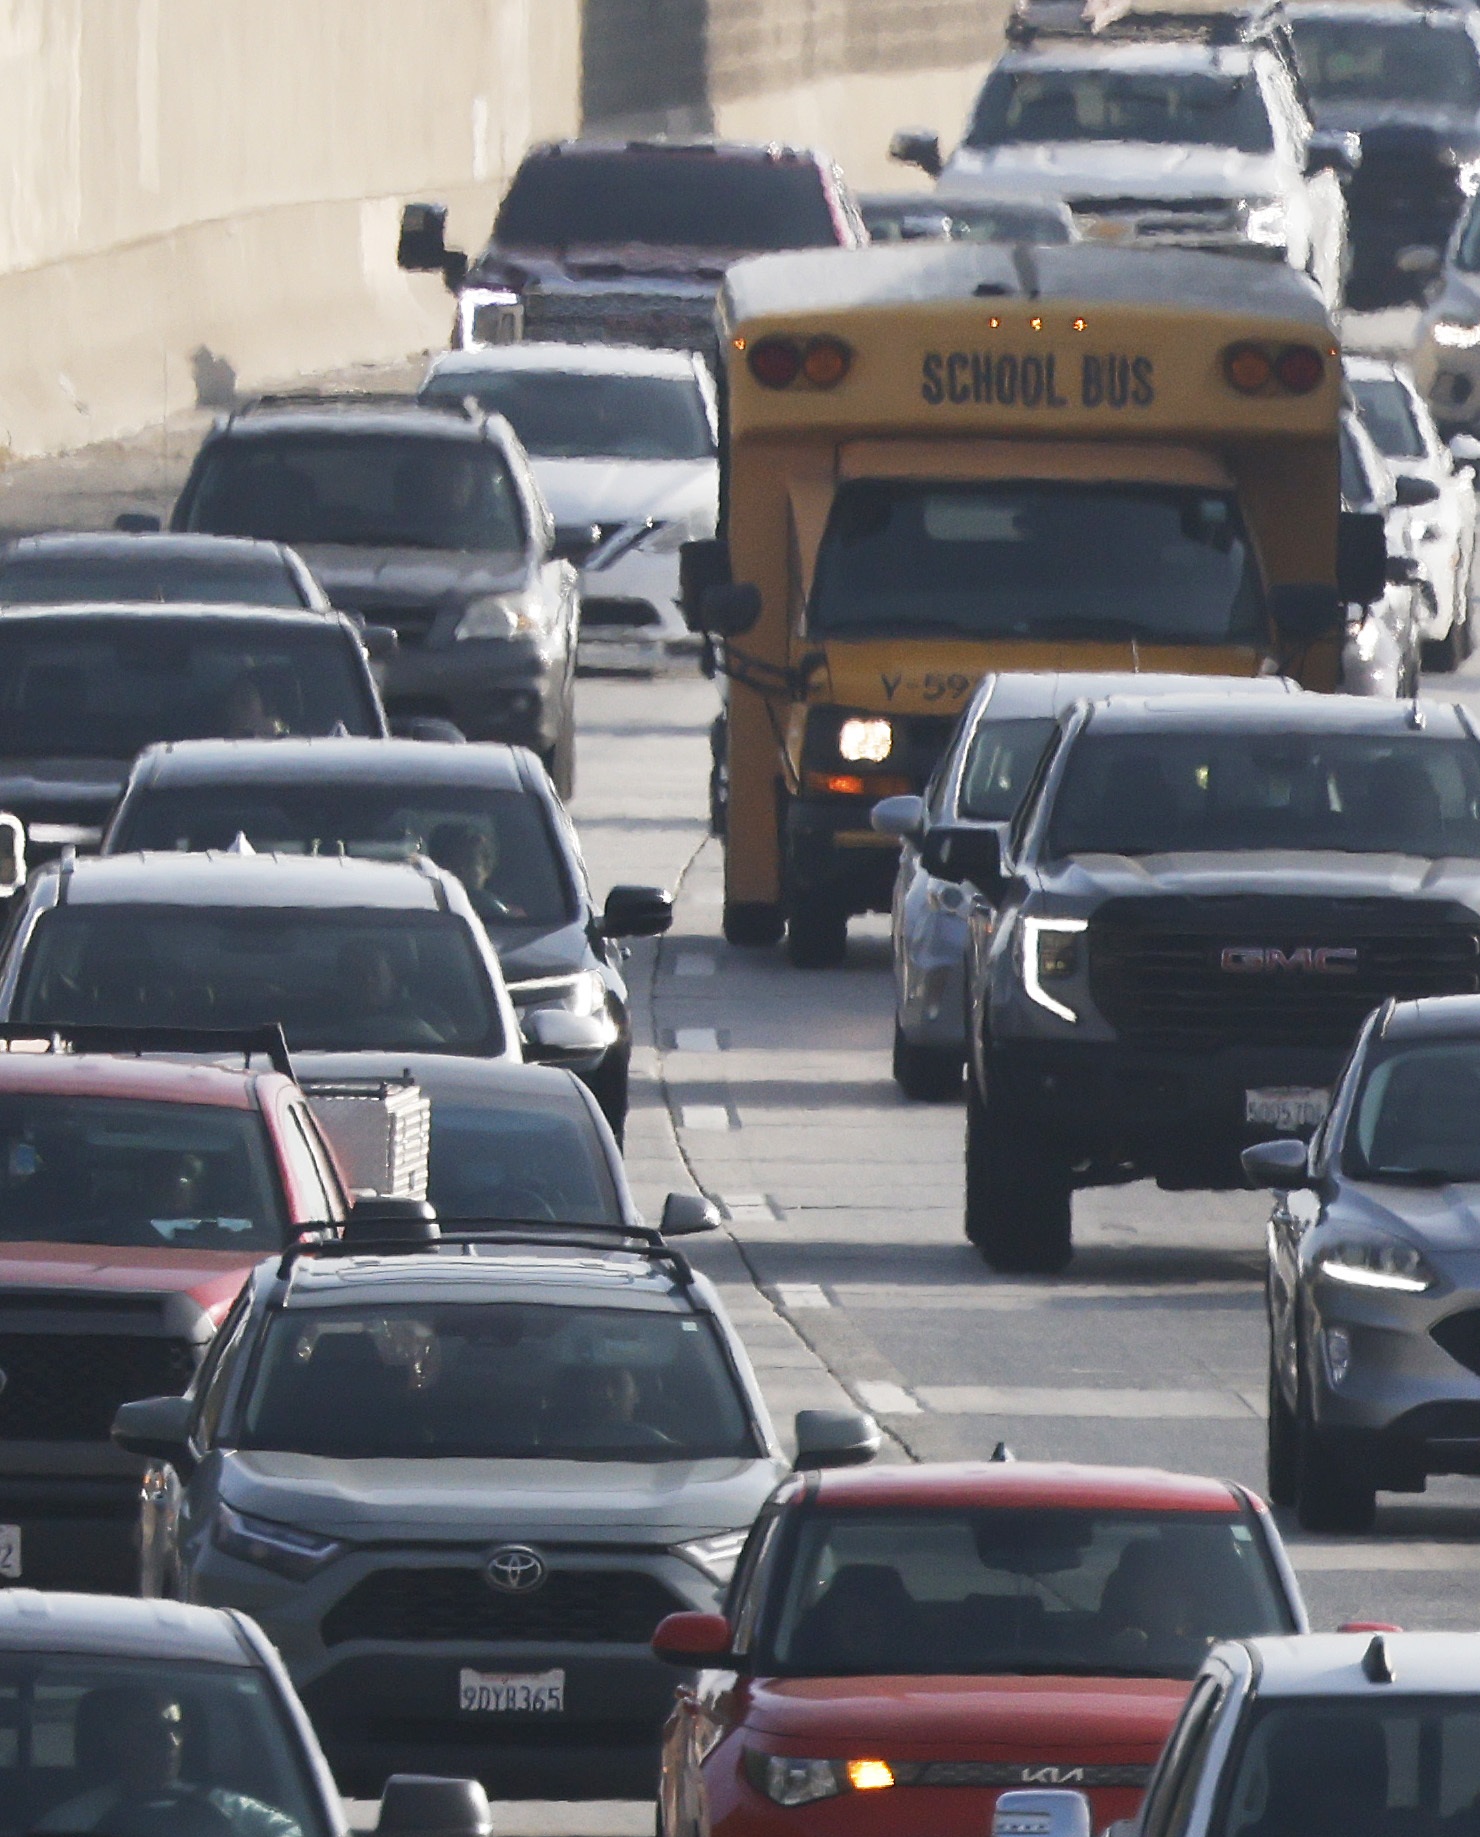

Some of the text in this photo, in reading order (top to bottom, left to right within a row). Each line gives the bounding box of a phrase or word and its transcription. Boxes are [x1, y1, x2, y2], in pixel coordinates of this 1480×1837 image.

[922, 352, 1155, 409] SCHOOL BUS
[1221, 947, 1358, 973] GMC
